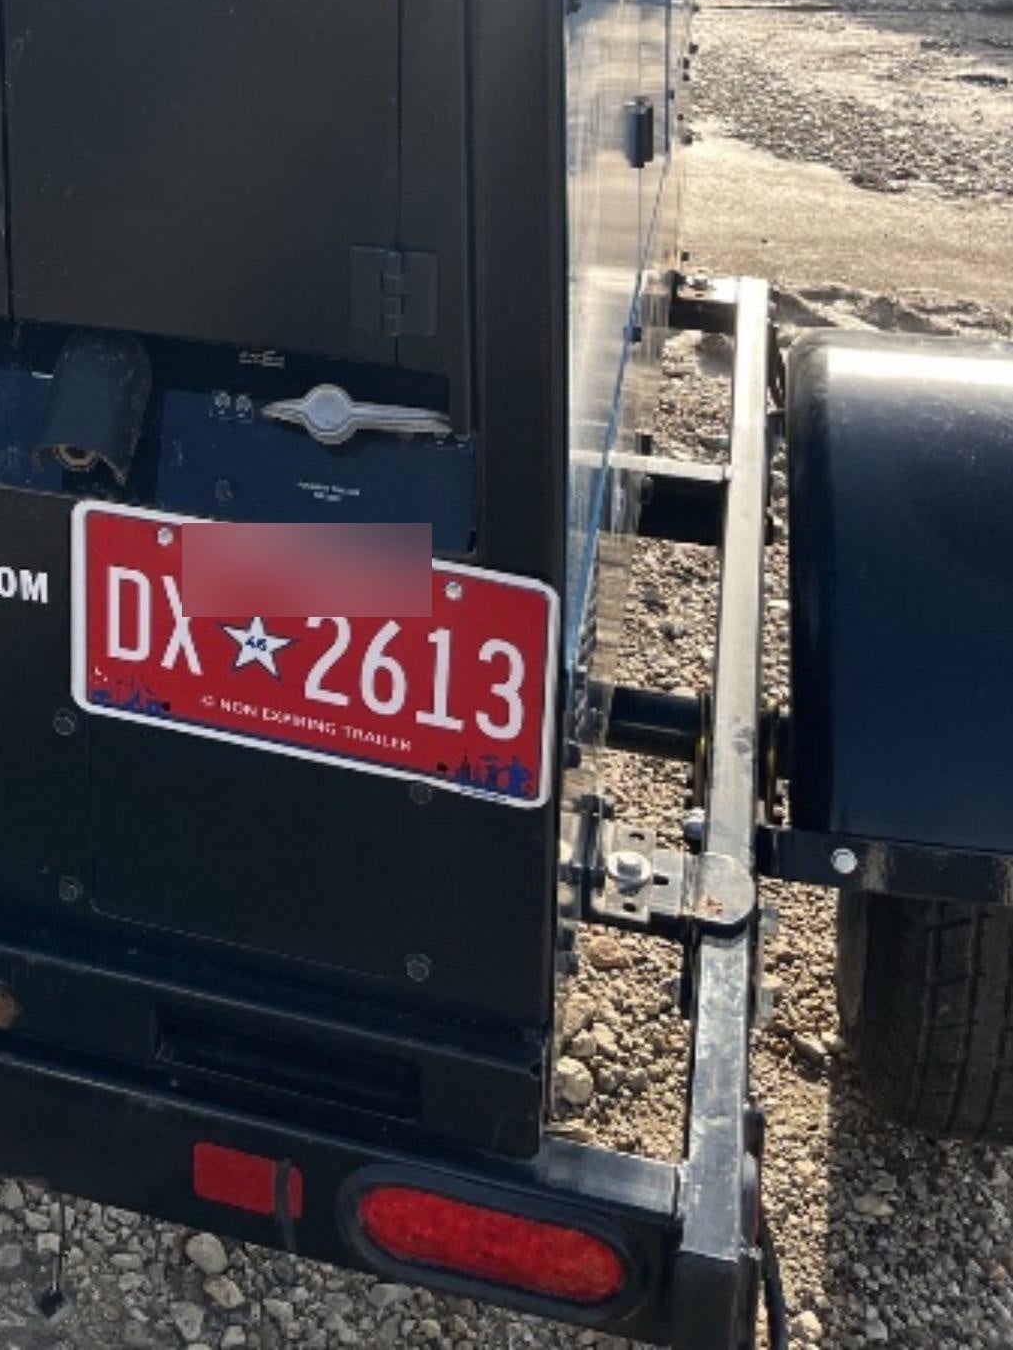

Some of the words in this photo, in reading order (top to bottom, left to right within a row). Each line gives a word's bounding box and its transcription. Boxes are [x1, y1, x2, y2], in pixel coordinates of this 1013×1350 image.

[107, 565, 204, 676] DX
[303, 616, 526, 741] 2613
[219, 697, 258, 717] NON
[262, 707, 337, 736] EXPIRING
[343, 725, 411, 752] TRAILER
